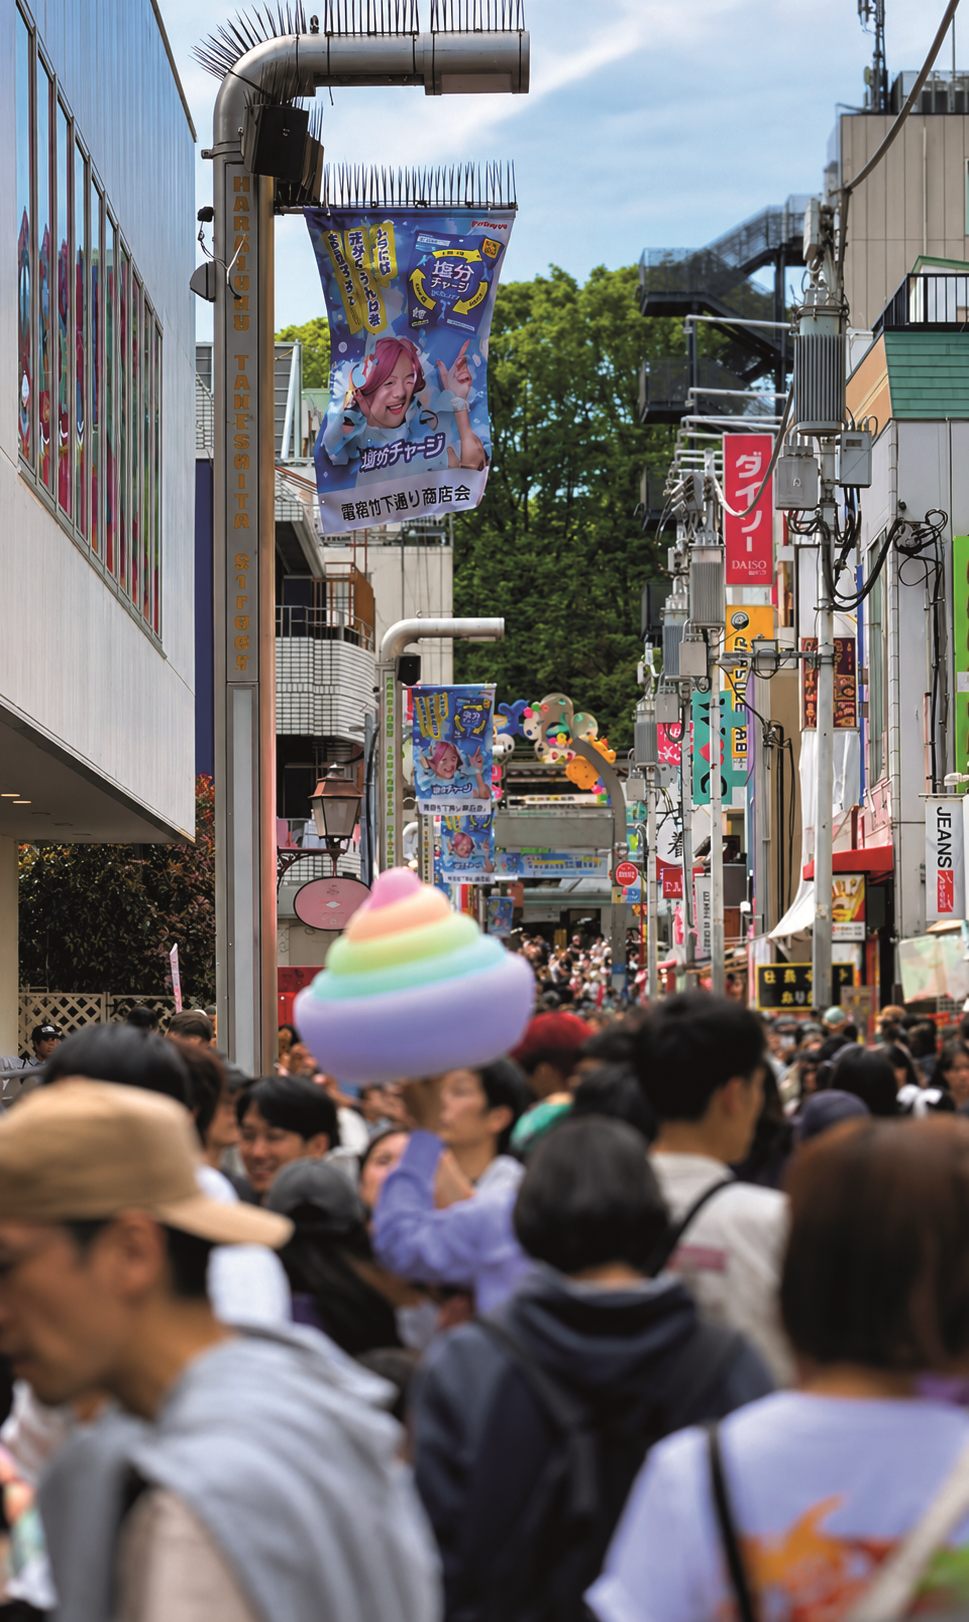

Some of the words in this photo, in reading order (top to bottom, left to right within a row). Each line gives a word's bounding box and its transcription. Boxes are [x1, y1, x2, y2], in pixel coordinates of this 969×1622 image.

[233, 176, 250, 331] HARAJUKU
[431, 260, 475, 281] 塩分
[233, 354, 250, 529] TAKESHITA
[735, 451, 763, 552] ダイソー
[731, 560, 767, 570] DAISO
[936, 806, 952, 869] JEANS
